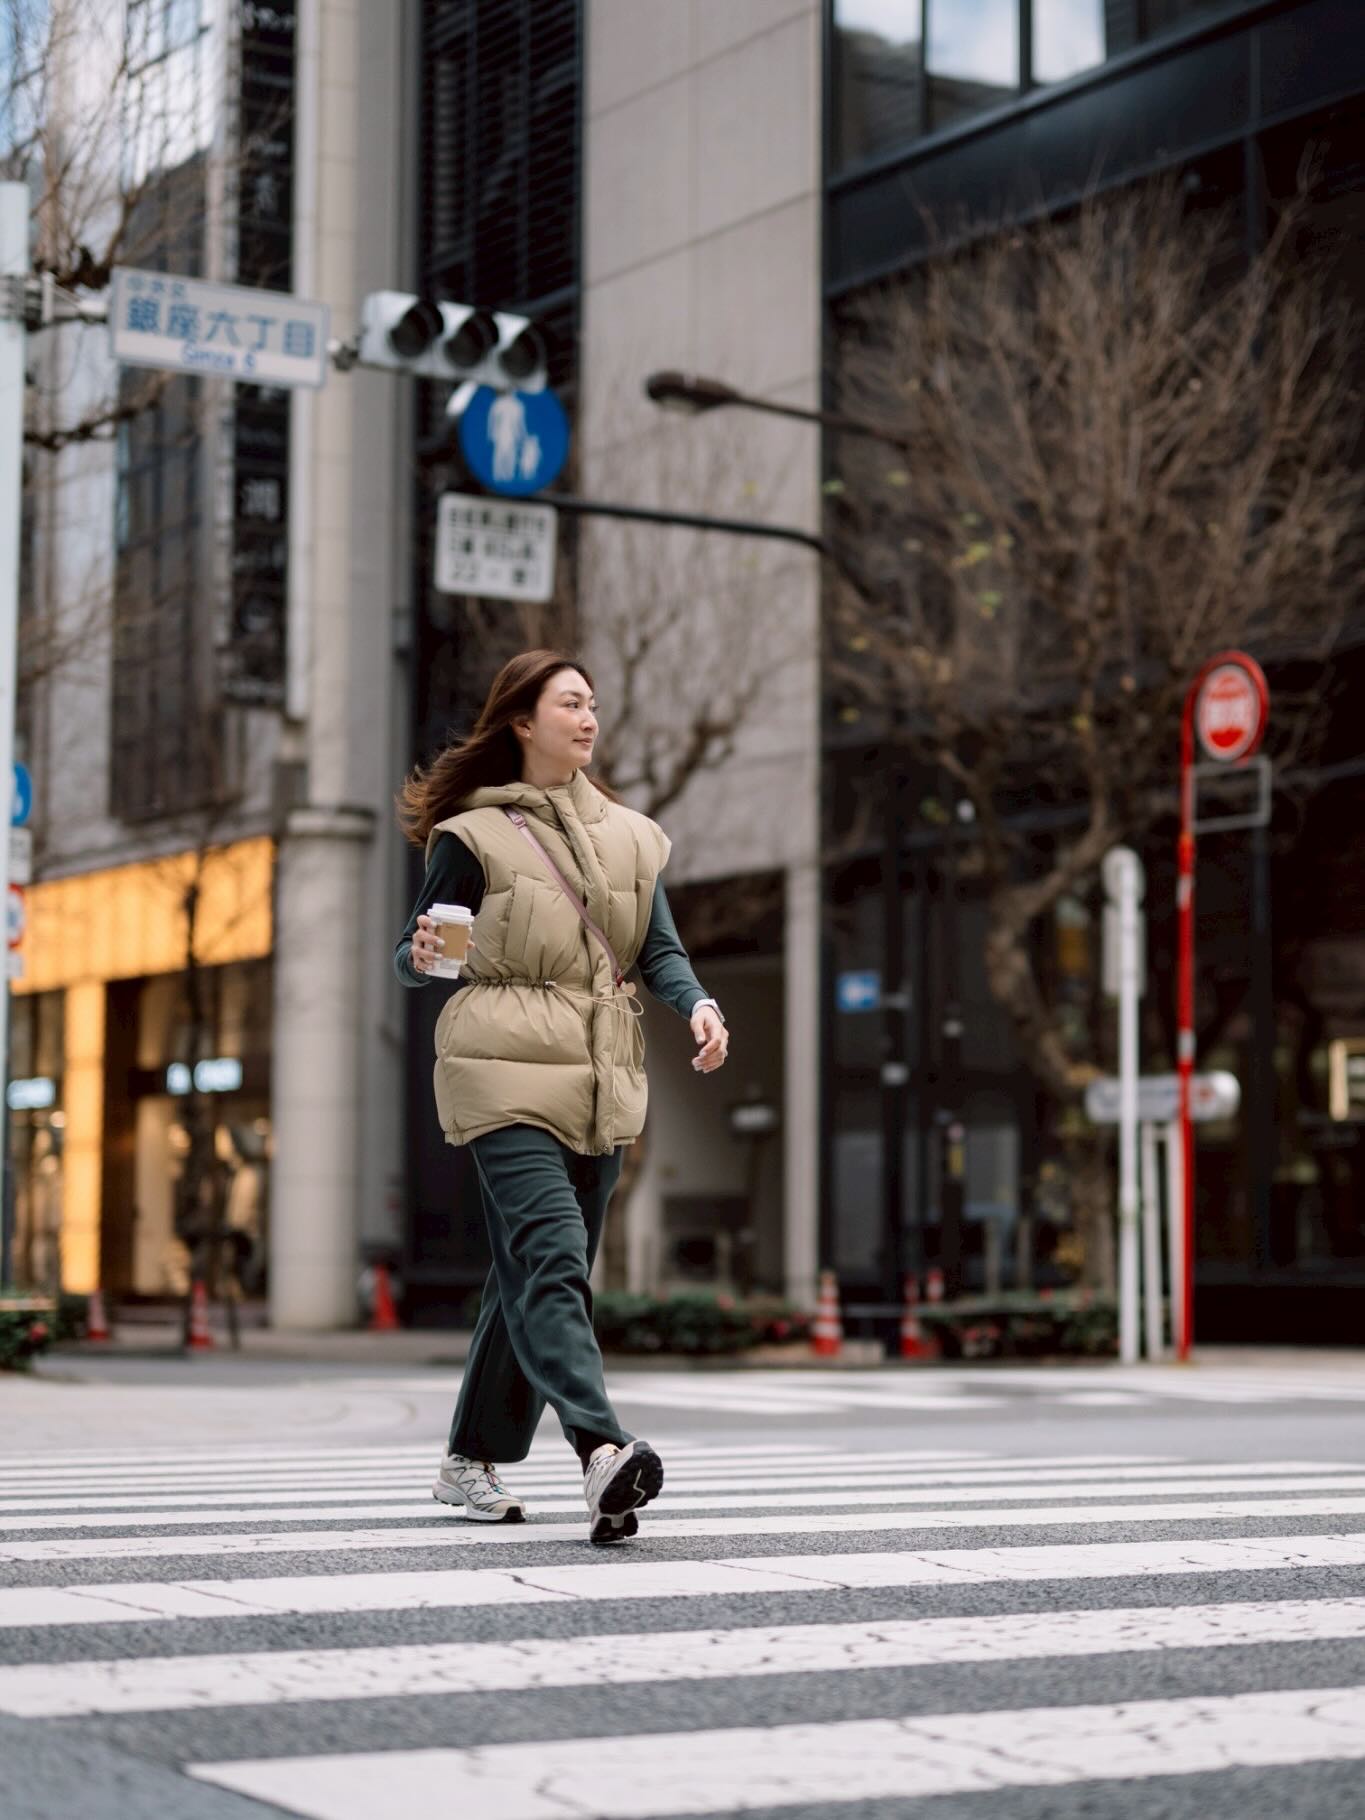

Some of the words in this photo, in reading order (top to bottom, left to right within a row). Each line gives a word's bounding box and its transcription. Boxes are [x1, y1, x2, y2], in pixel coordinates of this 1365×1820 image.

[126, 299, 316, 358] 銀座六丁目
